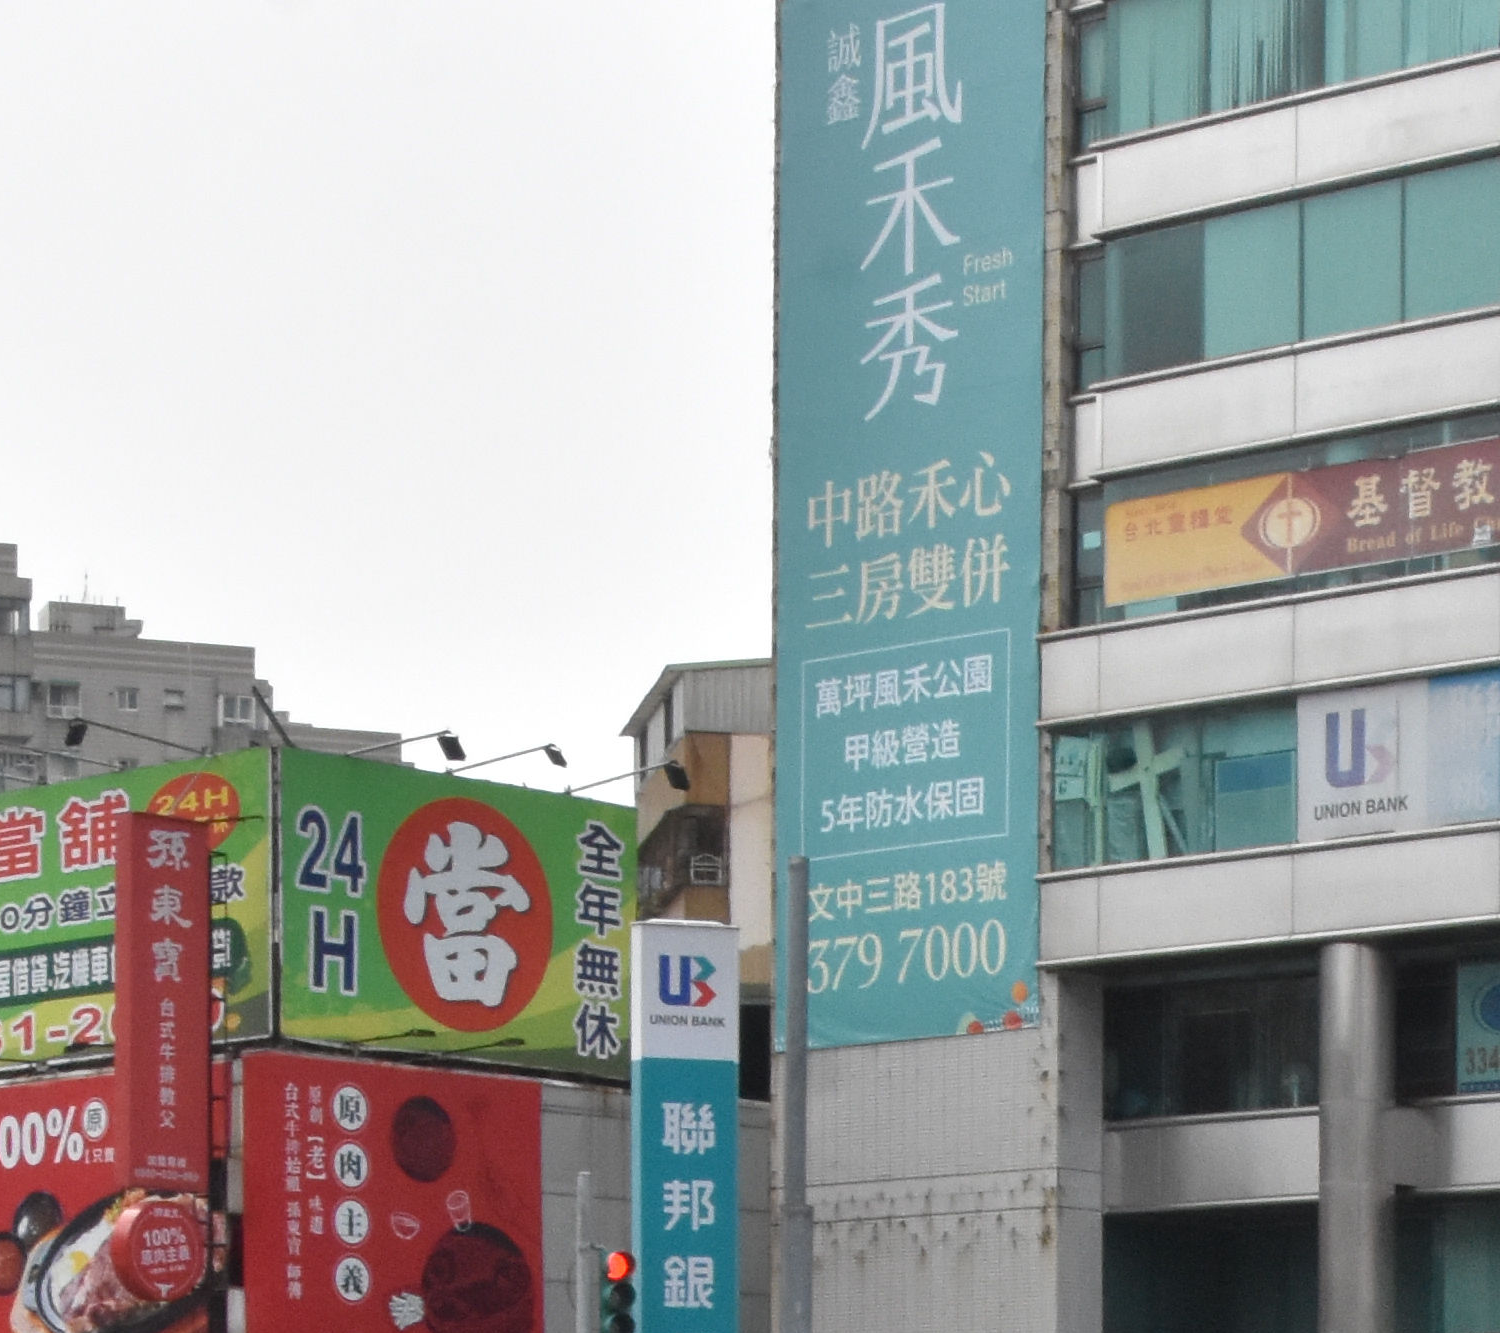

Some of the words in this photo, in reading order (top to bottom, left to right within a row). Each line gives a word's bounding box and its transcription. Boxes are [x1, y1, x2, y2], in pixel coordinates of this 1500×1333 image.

[825, 27, 863, 126] 誠鑫
[861, 2, 964, 424] 風禾秀
[961, 279, 1007, 308] Start
[962, 246, 1014, 275] Fresh
[806, 451, 1011, 548] 中路禾心
[1347, 531, 1395, 554] Bread
[1405, 527, 1422, 545] of
[1430, 522, 1463, 542] Life
[805, 534, 1011, 631] 三房雙併
[816, 654, 993, 718] 萬坪風禾公園
[844, 721, 961, 772] 甲級營造
[820, 776, 985, 834] 5年防水保固
[1314, 800, 1361, 821] UNION
[1365, 794, 1409, 816] BANK
[300, 805, 364, 895] 24
[404, 821, 531, 1007] 當
[808, 862, 1008, 924] 文中三路183號
[309, 906, 358, 995] H
[575, 823, 624, 1060] 全年無休
[806, 933, 884, 995] 379
[897, 918, 1008, 985] 7000
[650, 1014, 689, 1027] UNION
[693, 1014, 726, 1029] BANK
[335, 1090, 367, 1299] 原肉主義
